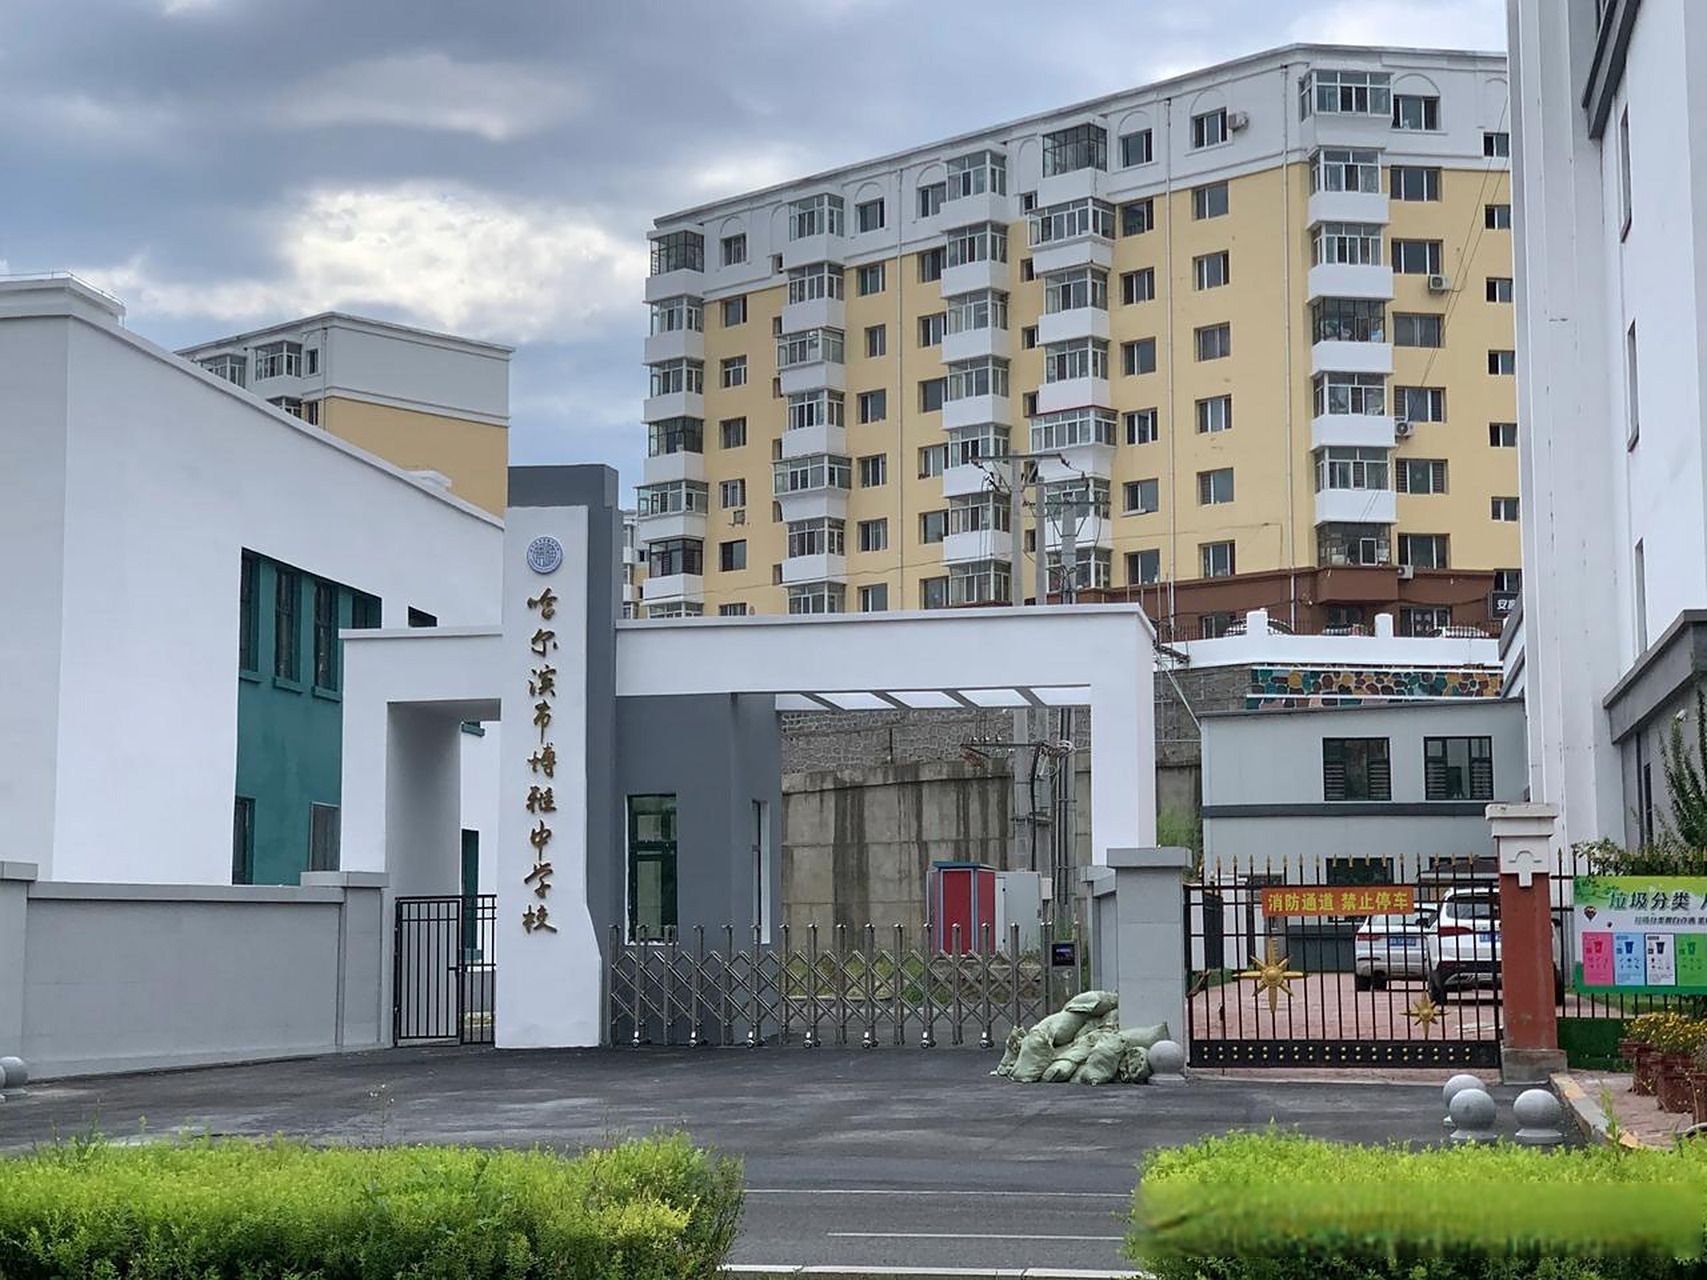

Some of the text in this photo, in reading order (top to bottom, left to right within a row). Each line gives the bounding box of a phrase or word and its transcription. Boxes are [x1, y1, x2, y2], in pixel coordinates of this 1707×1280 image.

[522, 587, 558, 934] 哈尔滨市博雅中学校
[1268, 891, 1408, 912] 消防通道 禁止停车
[1609, 890, 1690, 911] 垃圾分类
